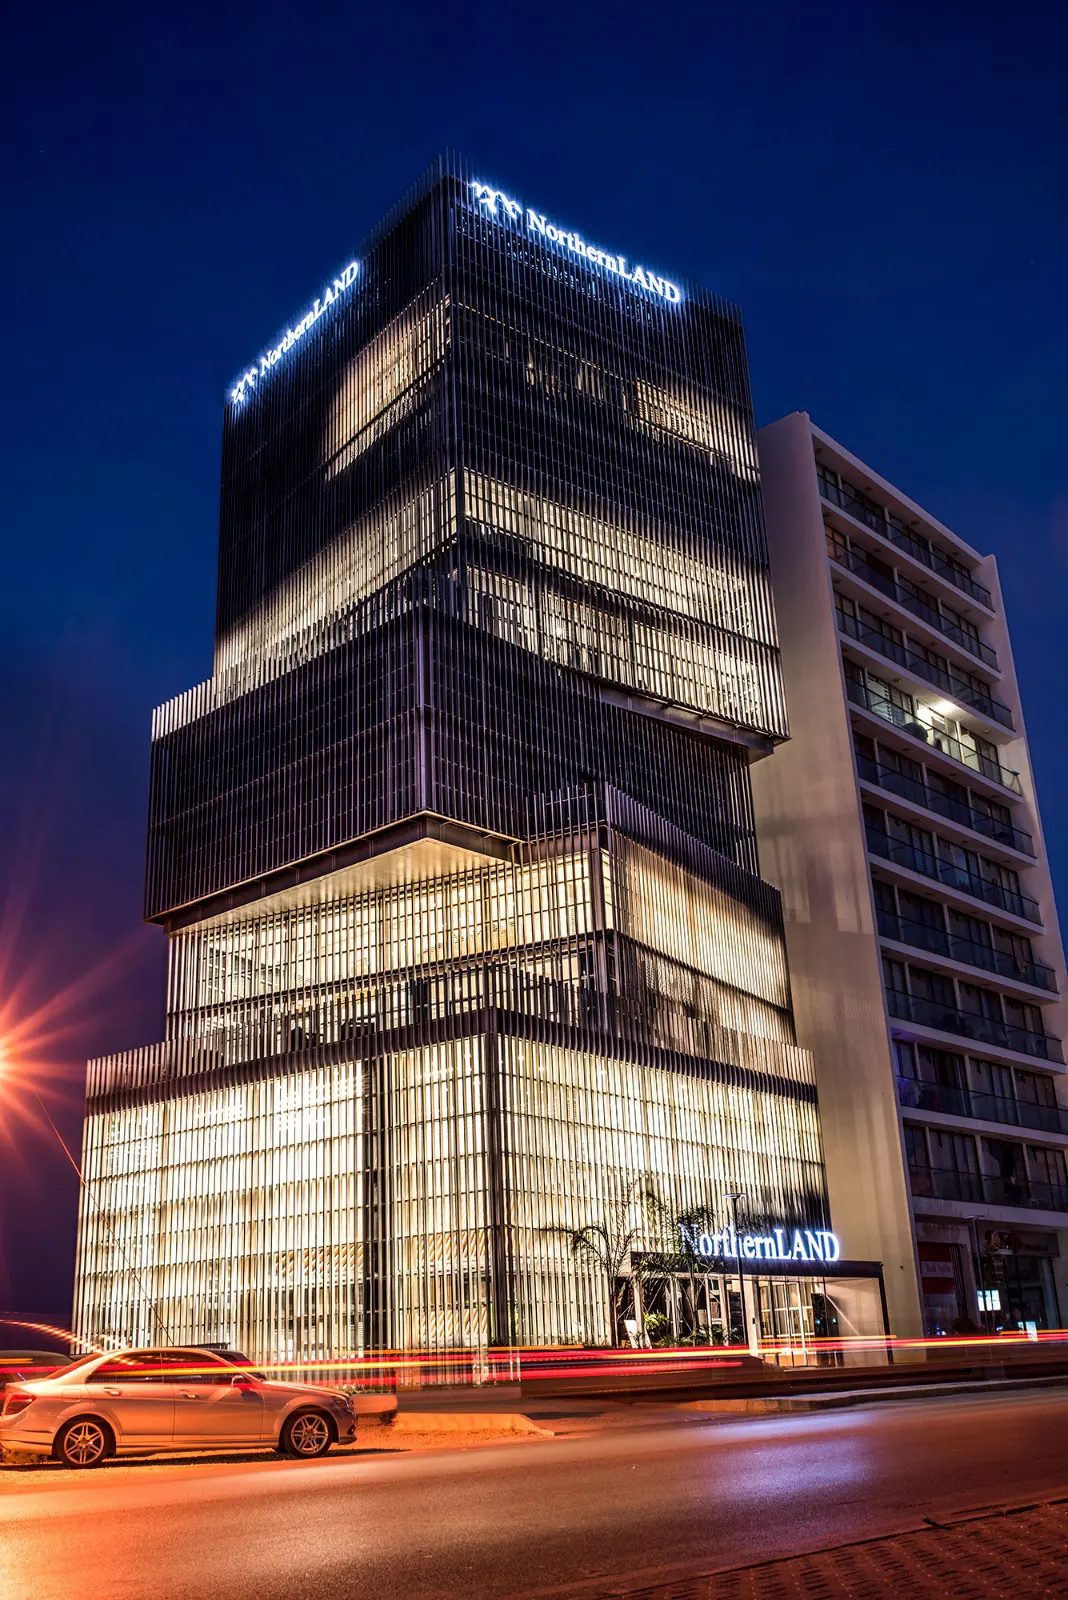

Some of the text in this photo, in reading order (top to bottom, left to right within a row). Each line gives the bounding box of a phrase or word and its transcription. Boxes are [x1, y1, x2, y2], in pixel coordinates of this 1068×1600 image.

[527, 208, 681, 303] NorthernLAND
[260, 261, 359, 377] NorthernLAND
[678, 1223, 840, 1262] NorthernLAND
